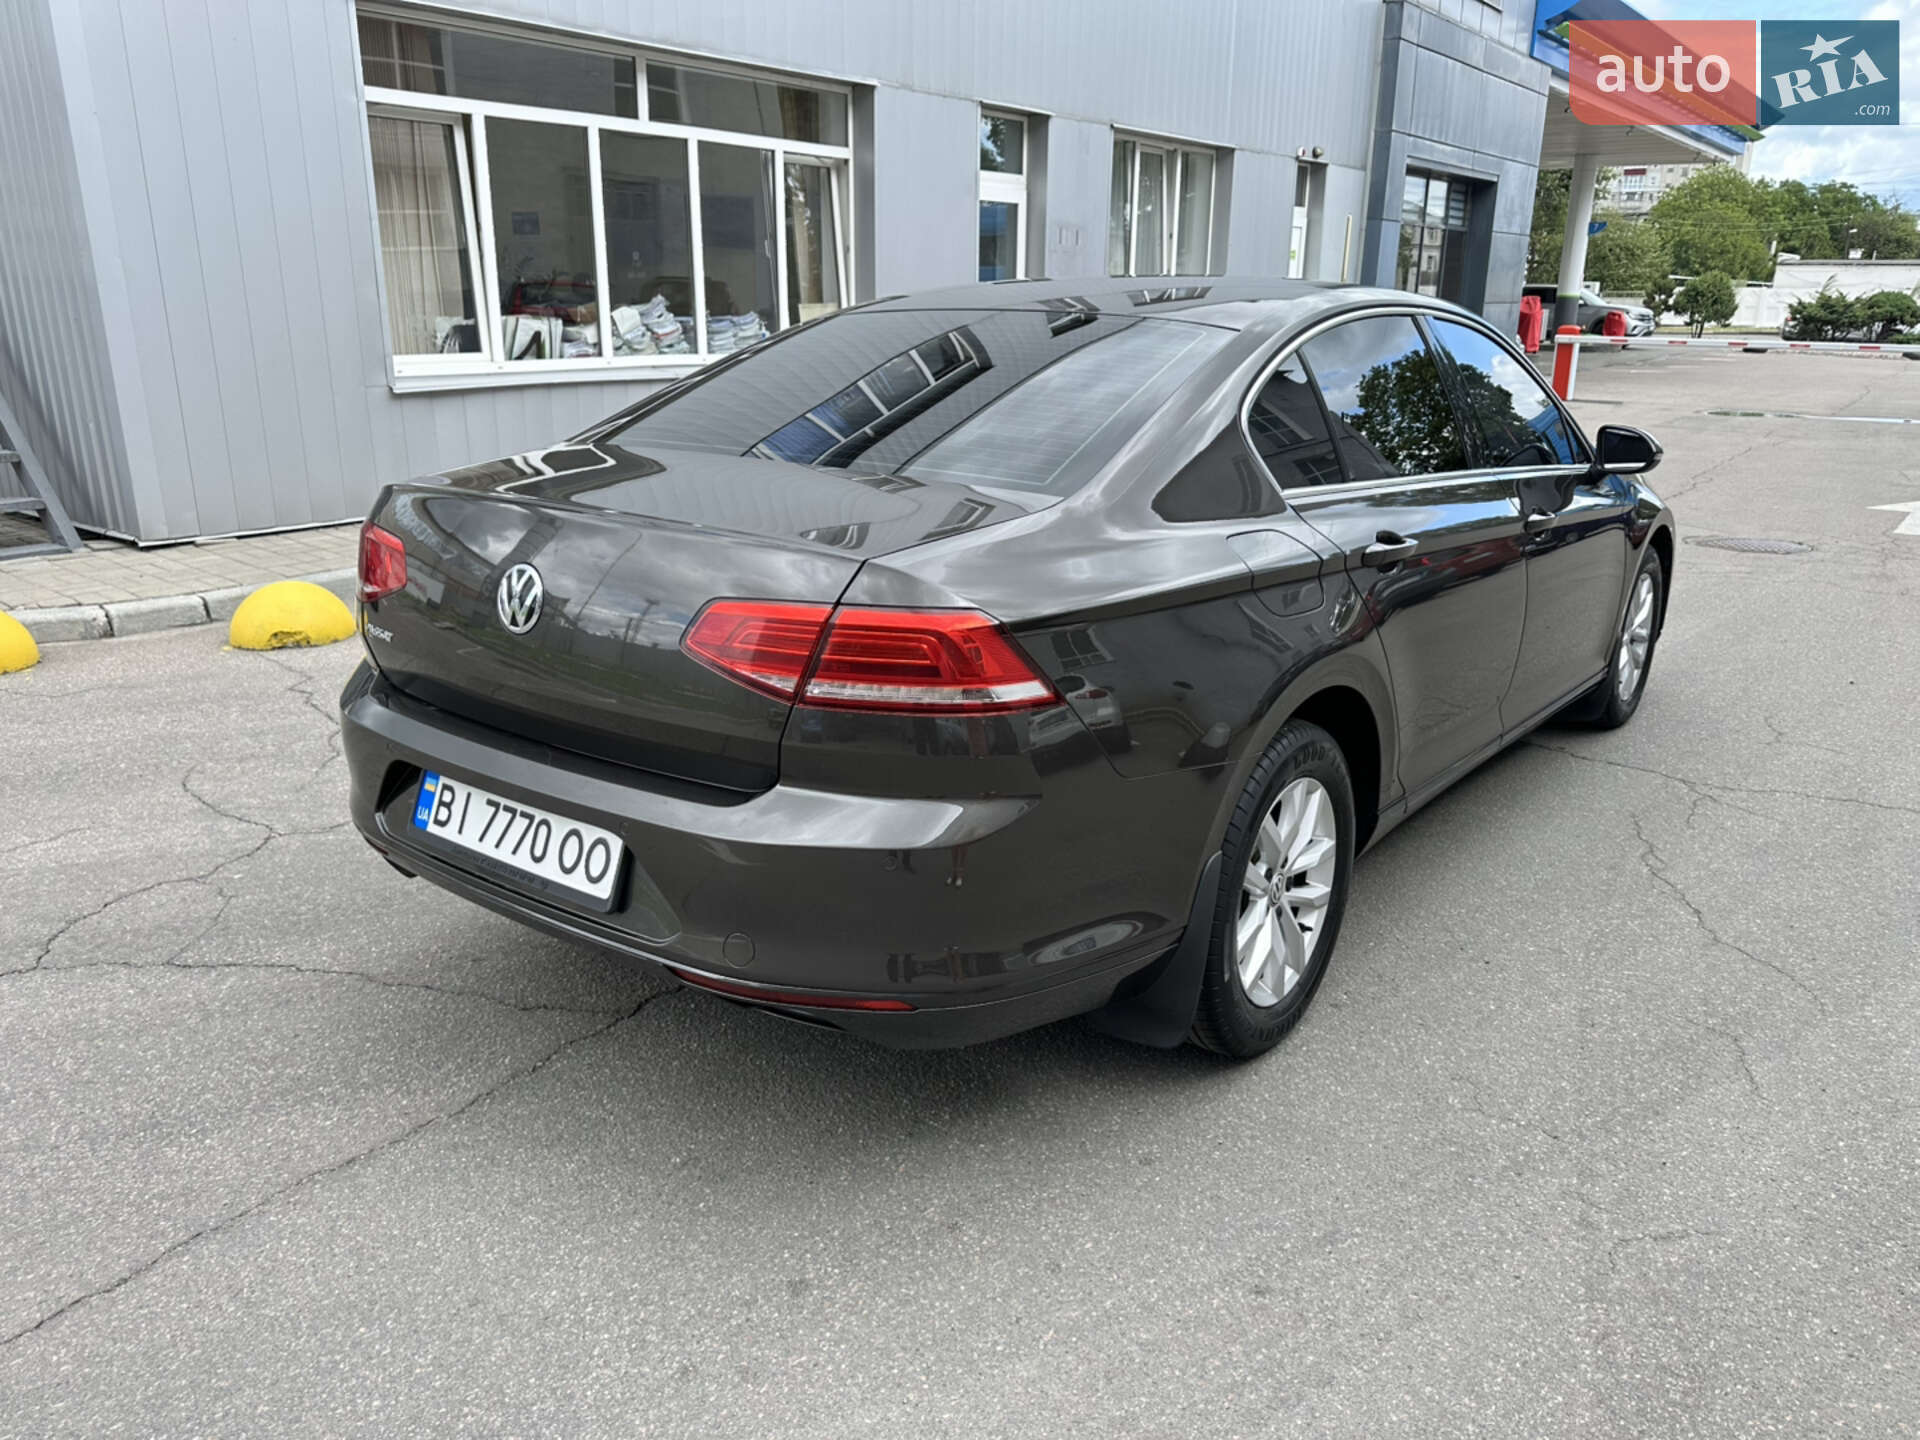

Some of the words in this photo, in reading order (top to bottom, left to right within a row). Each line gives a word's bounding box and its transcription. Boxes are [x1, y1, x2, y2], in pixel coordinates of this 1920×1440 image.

[417, 806, 429, 822] UA
[433, 782, 471, 835] BI
[478, 798, 552, 864] 7770
